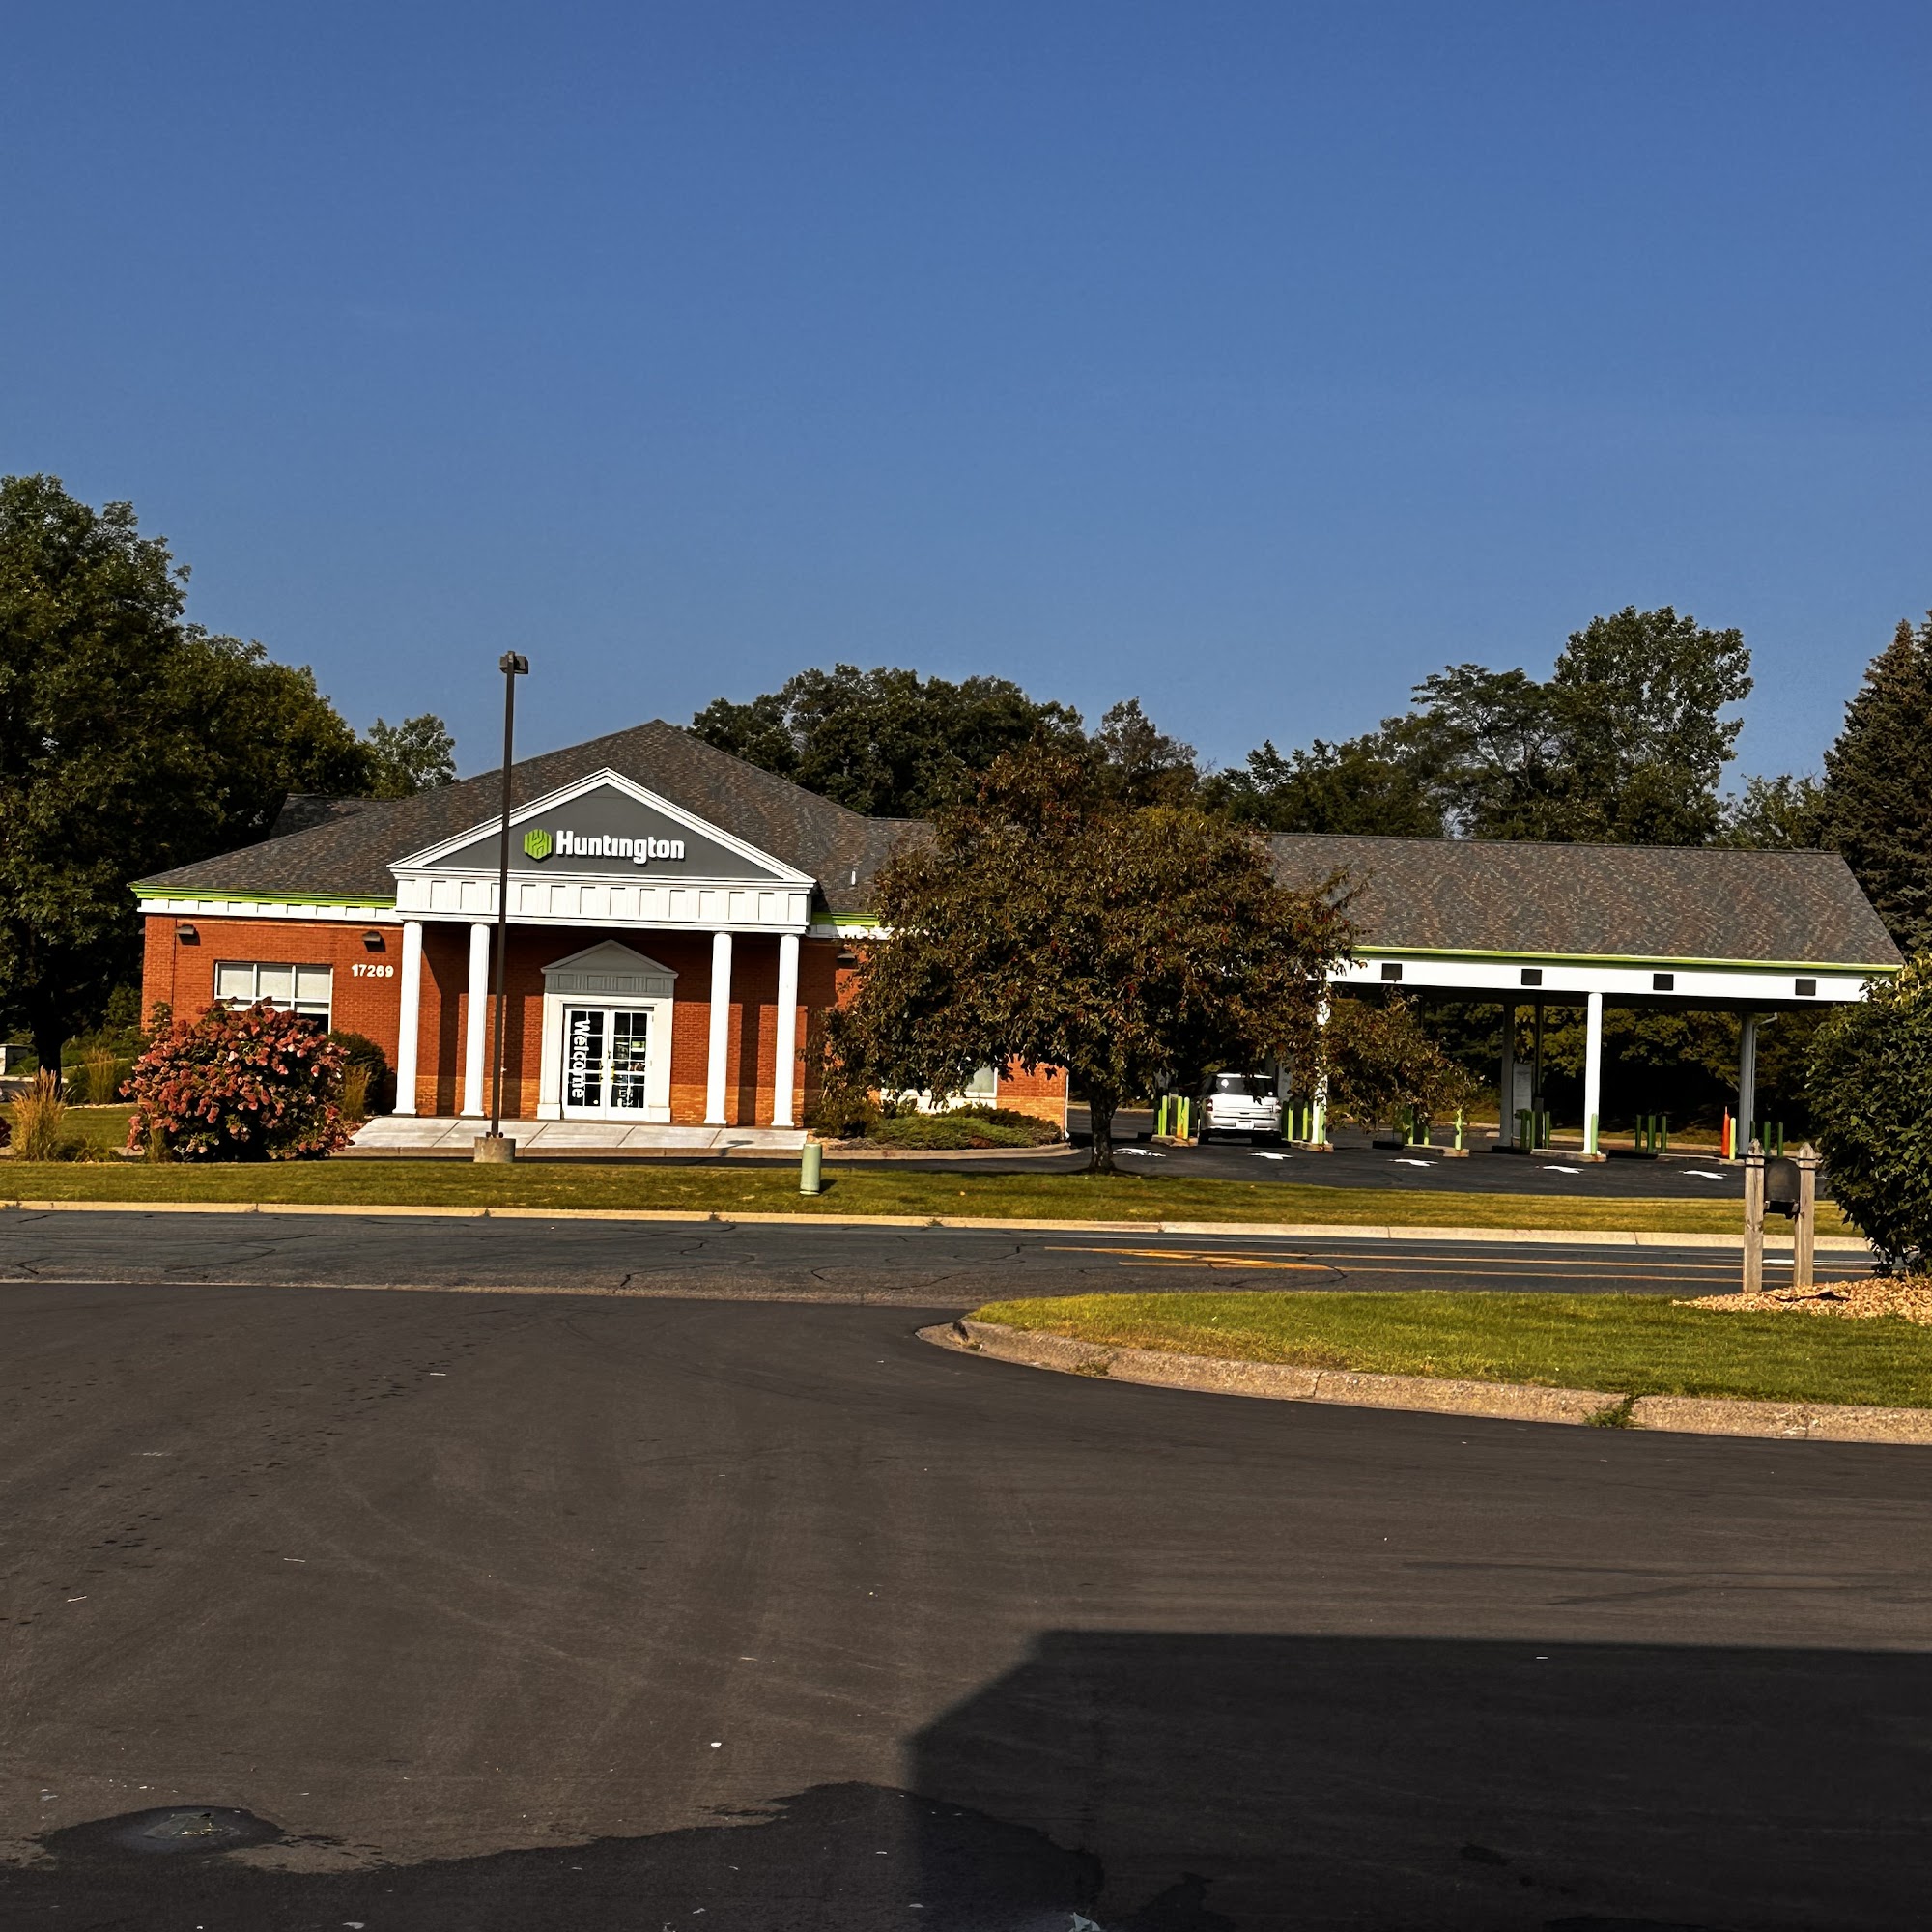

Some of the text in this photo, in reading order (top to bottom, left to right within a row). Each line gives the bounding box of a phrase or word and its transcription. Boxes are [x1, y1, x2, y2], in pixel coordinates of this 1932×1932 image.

[555, 830, 685, 865] Huntington
[351, 963, 394, 978] 17269
[571, 1019, 591, 1099] Welcome
